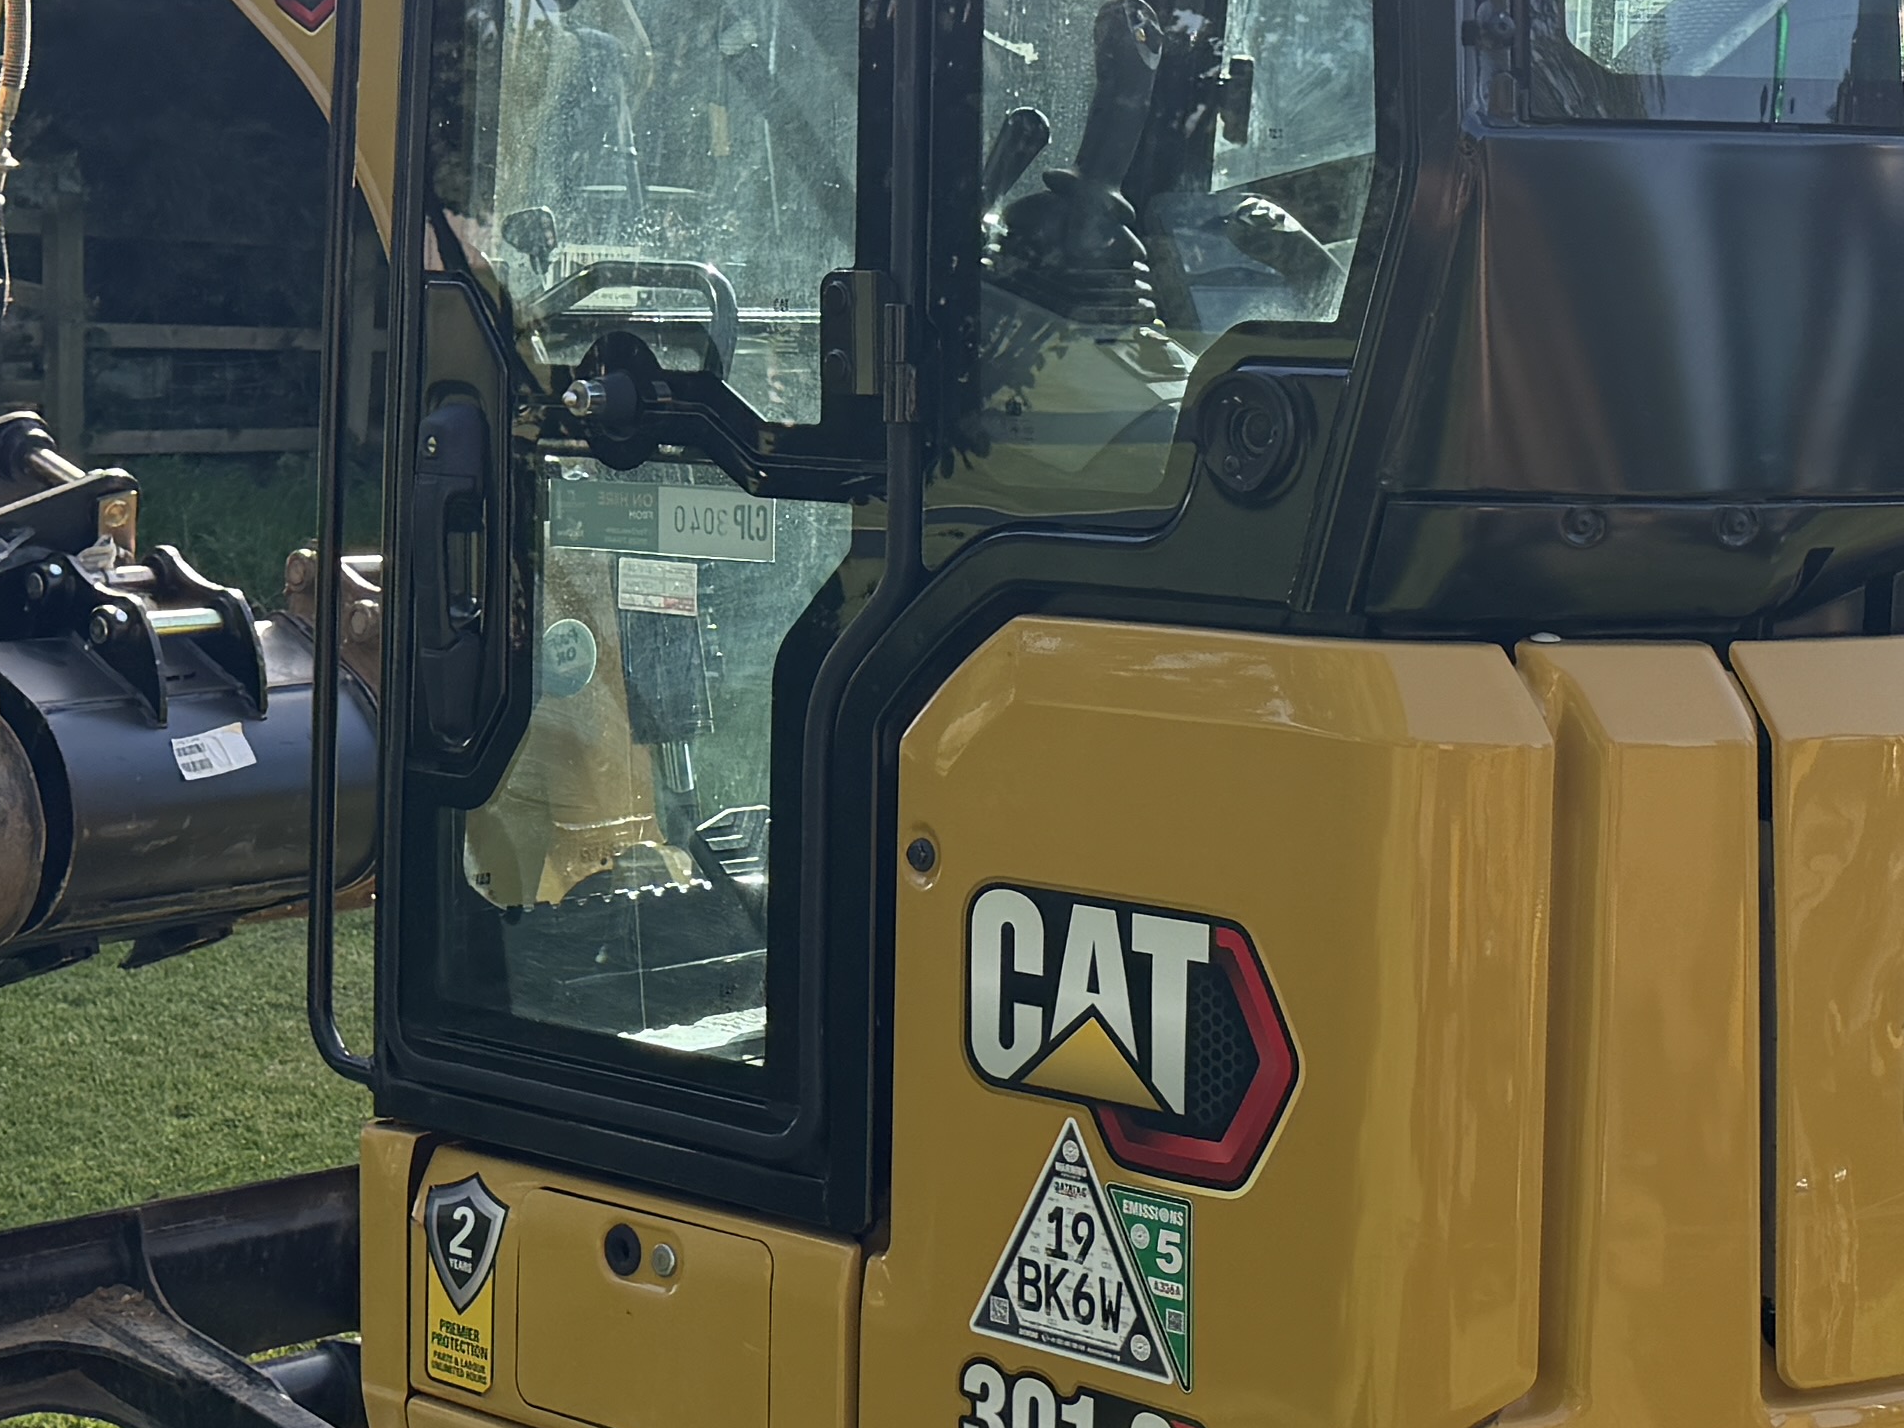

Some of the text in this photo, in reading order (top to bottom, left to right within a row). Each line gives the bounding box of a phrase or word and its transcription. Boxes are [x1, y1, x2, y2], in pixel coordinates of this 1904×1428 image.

[971, 888, 1210, 1116] CAT
[1122, 1199, 1184, 1226] EMISSIONS
[449, 1206, 476, 1258] 2
[1047, 1206, 1095, 1265] 19
[448, 1258, 473, 1274] YEARS
[1155, 1228, 1183, 1274] 5
[1017, 1256, 1123, 1333] BK6W
[431, 1332, 489, 1360] PROTECTION
[439, 1319, 480, 1343] PREMIER
[431, 1360, 488, 1385] UNLIMITED HOURS
